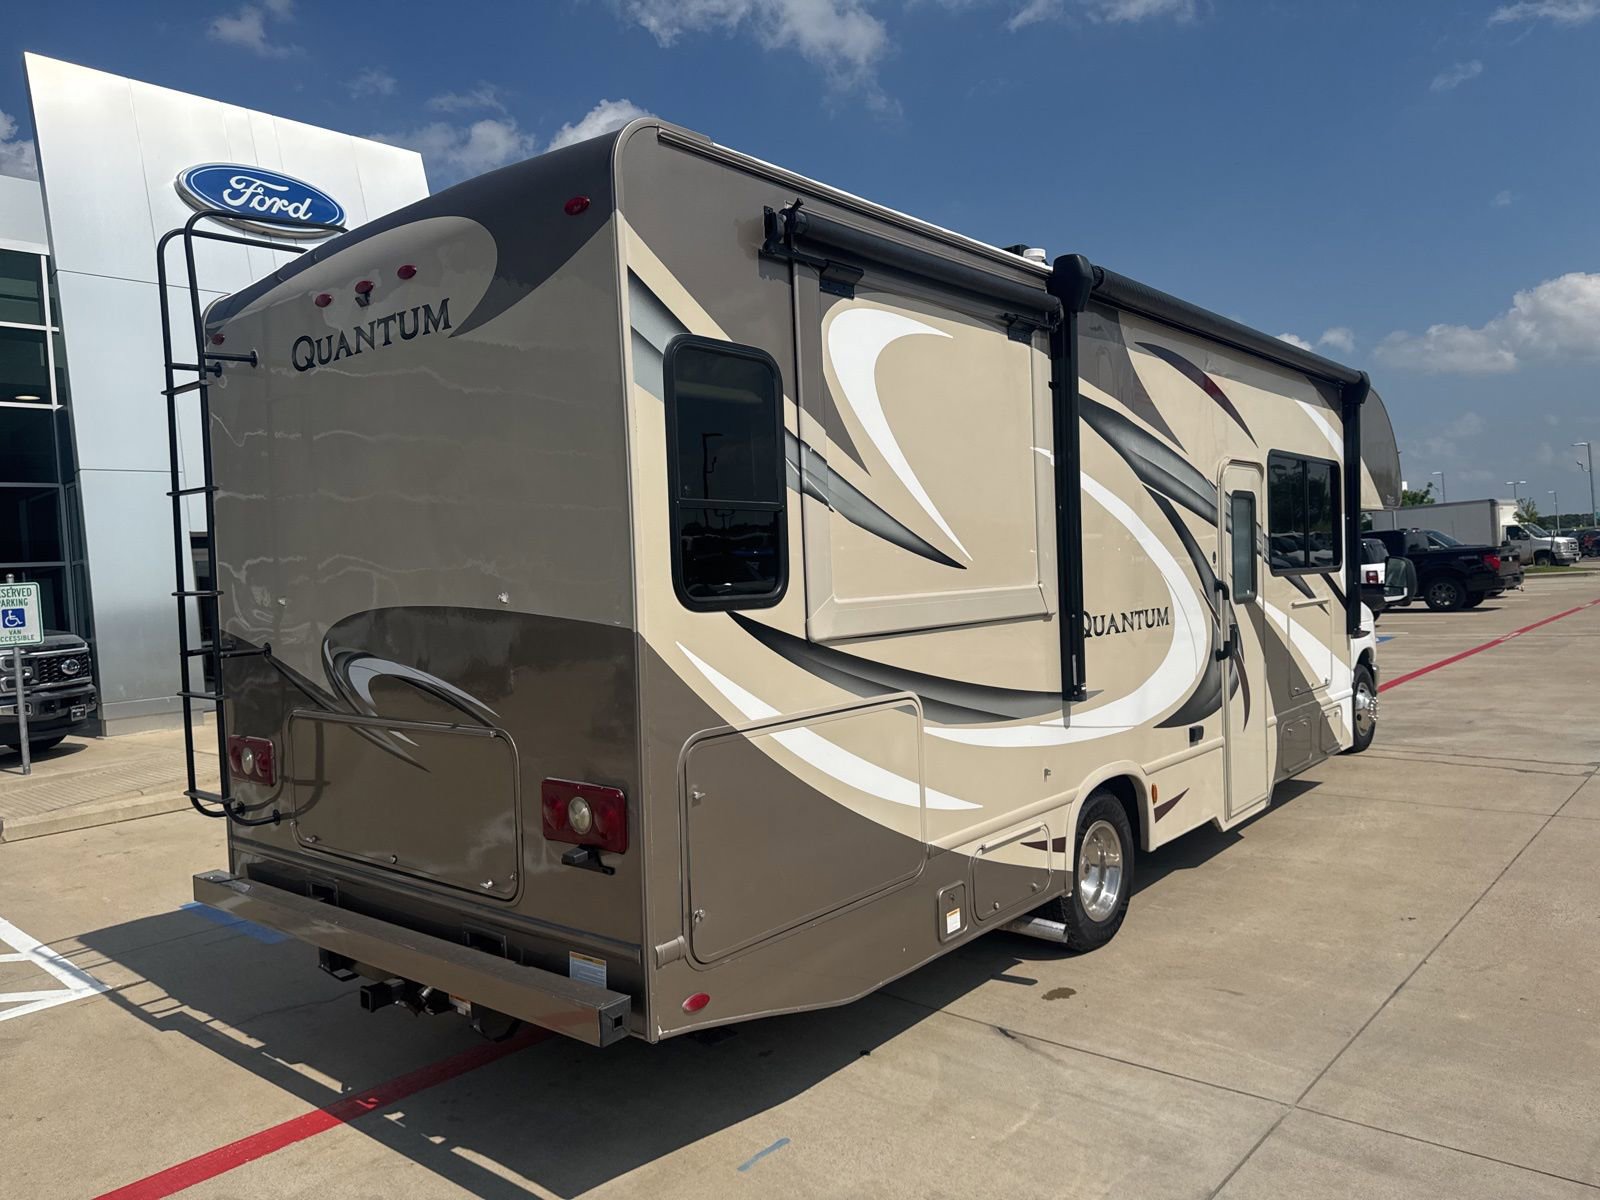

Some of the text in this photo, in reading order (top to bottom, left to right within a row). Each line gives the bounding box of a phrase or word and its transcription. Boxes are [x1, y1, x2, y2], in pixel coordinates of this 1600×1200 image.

[222, 175, 313, 221] Ford
[291, 297, 453, 373] QUANTUM
[0, 587, 32, 598] SERVED
[0, 598, 28, 607] ARKING
